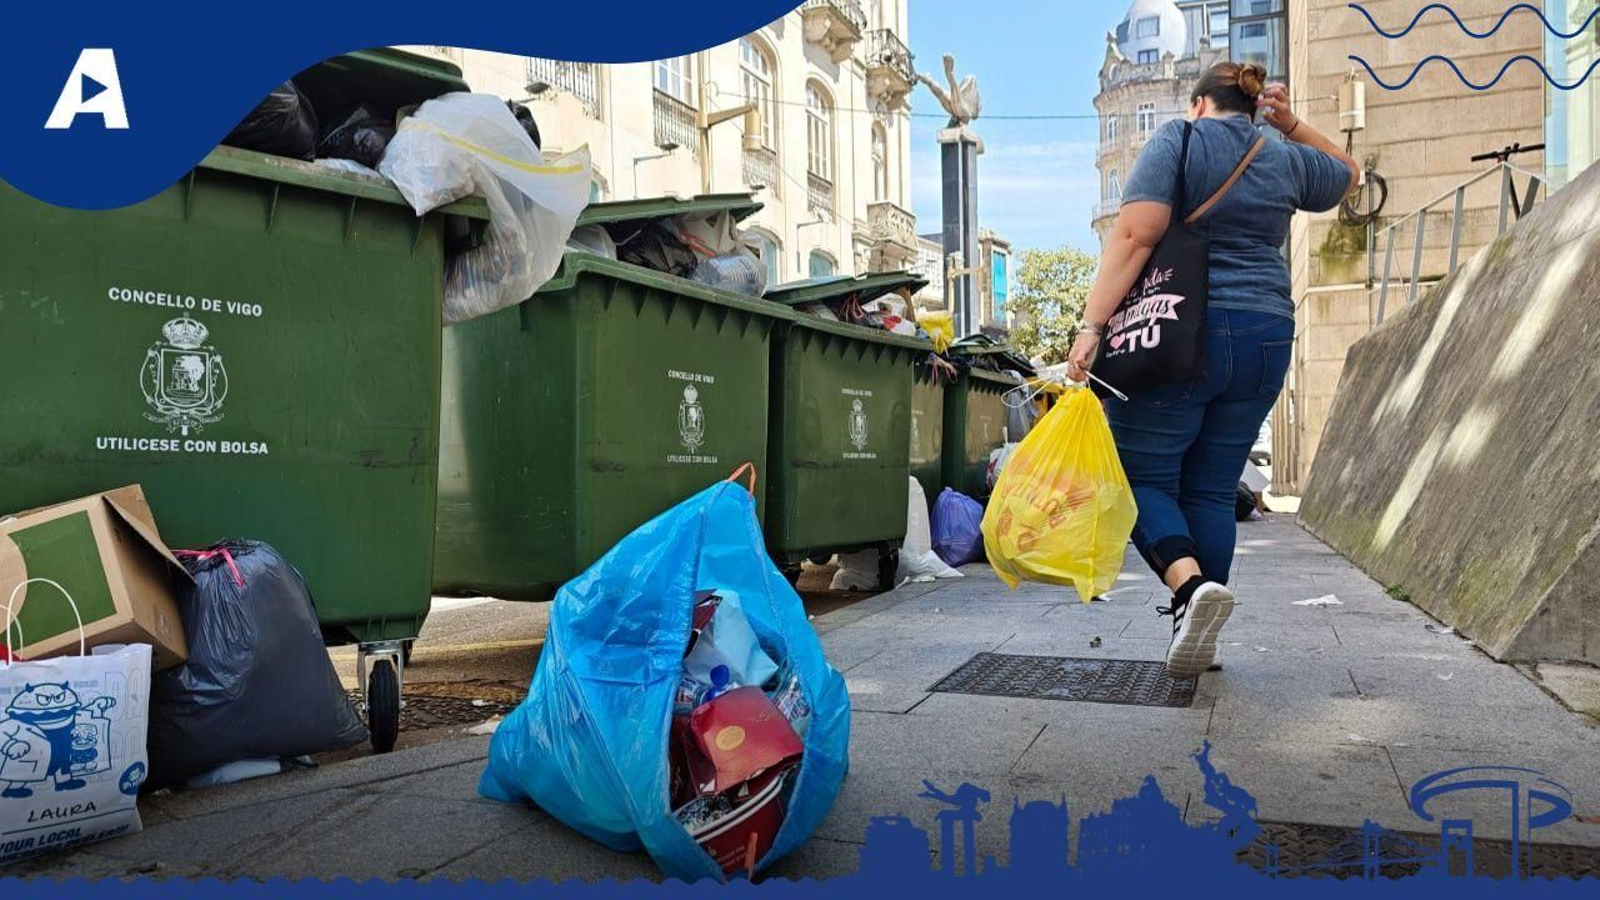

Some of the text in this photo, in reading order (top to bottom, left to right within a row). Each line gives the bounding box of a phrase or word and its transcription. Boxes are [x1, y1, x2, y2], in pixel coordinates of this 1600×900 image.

[108, 287, 262, 317] CONCELLO DE VIGO
[96, 437, 268, 454] UTILICESE CON BOLSA
[27, 801, 97, 823] LAURA
[39, 827, 81, 846] LOCAL
